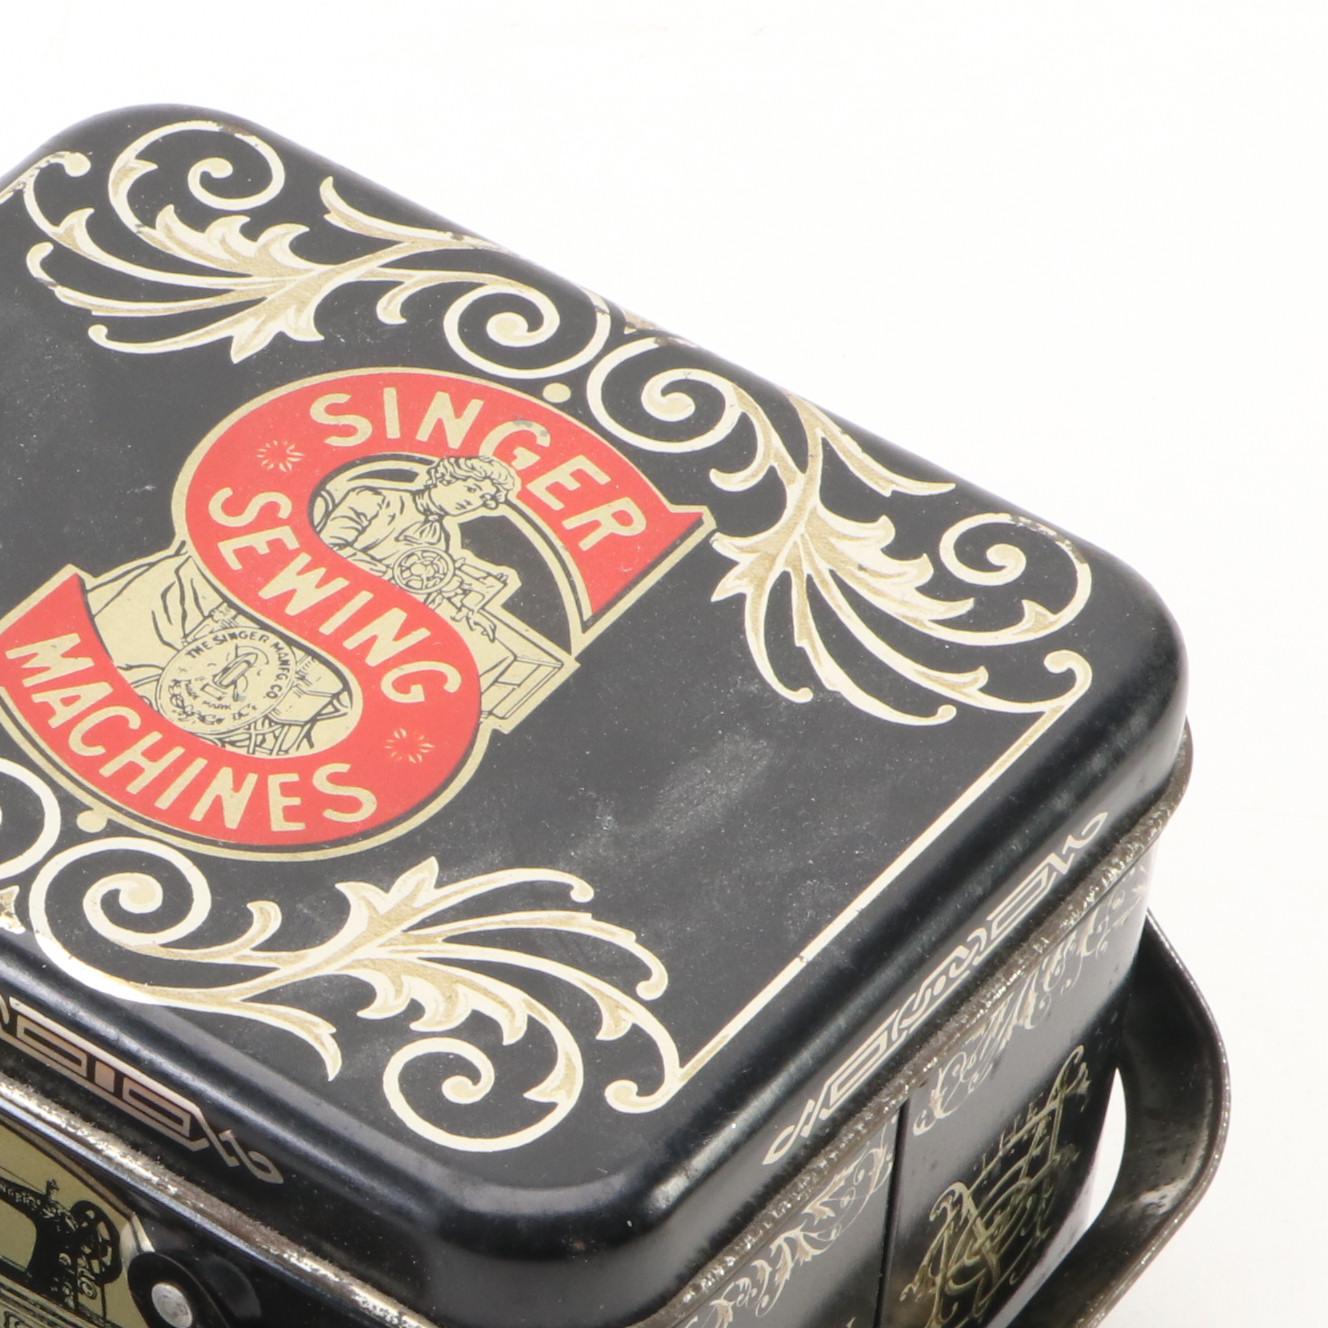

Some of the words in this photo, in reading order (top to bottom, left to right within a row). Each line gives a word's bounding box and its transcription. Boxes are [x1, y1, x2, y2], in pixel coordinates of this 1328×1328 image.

[310, 387, 647, 553] SINGER
[186, 641, 212, 659] THE
[213, 630, 270, 646] SINGER
[209, 486, 460, 704] SEWING
[4, 632, 378, 833] MACHINES
